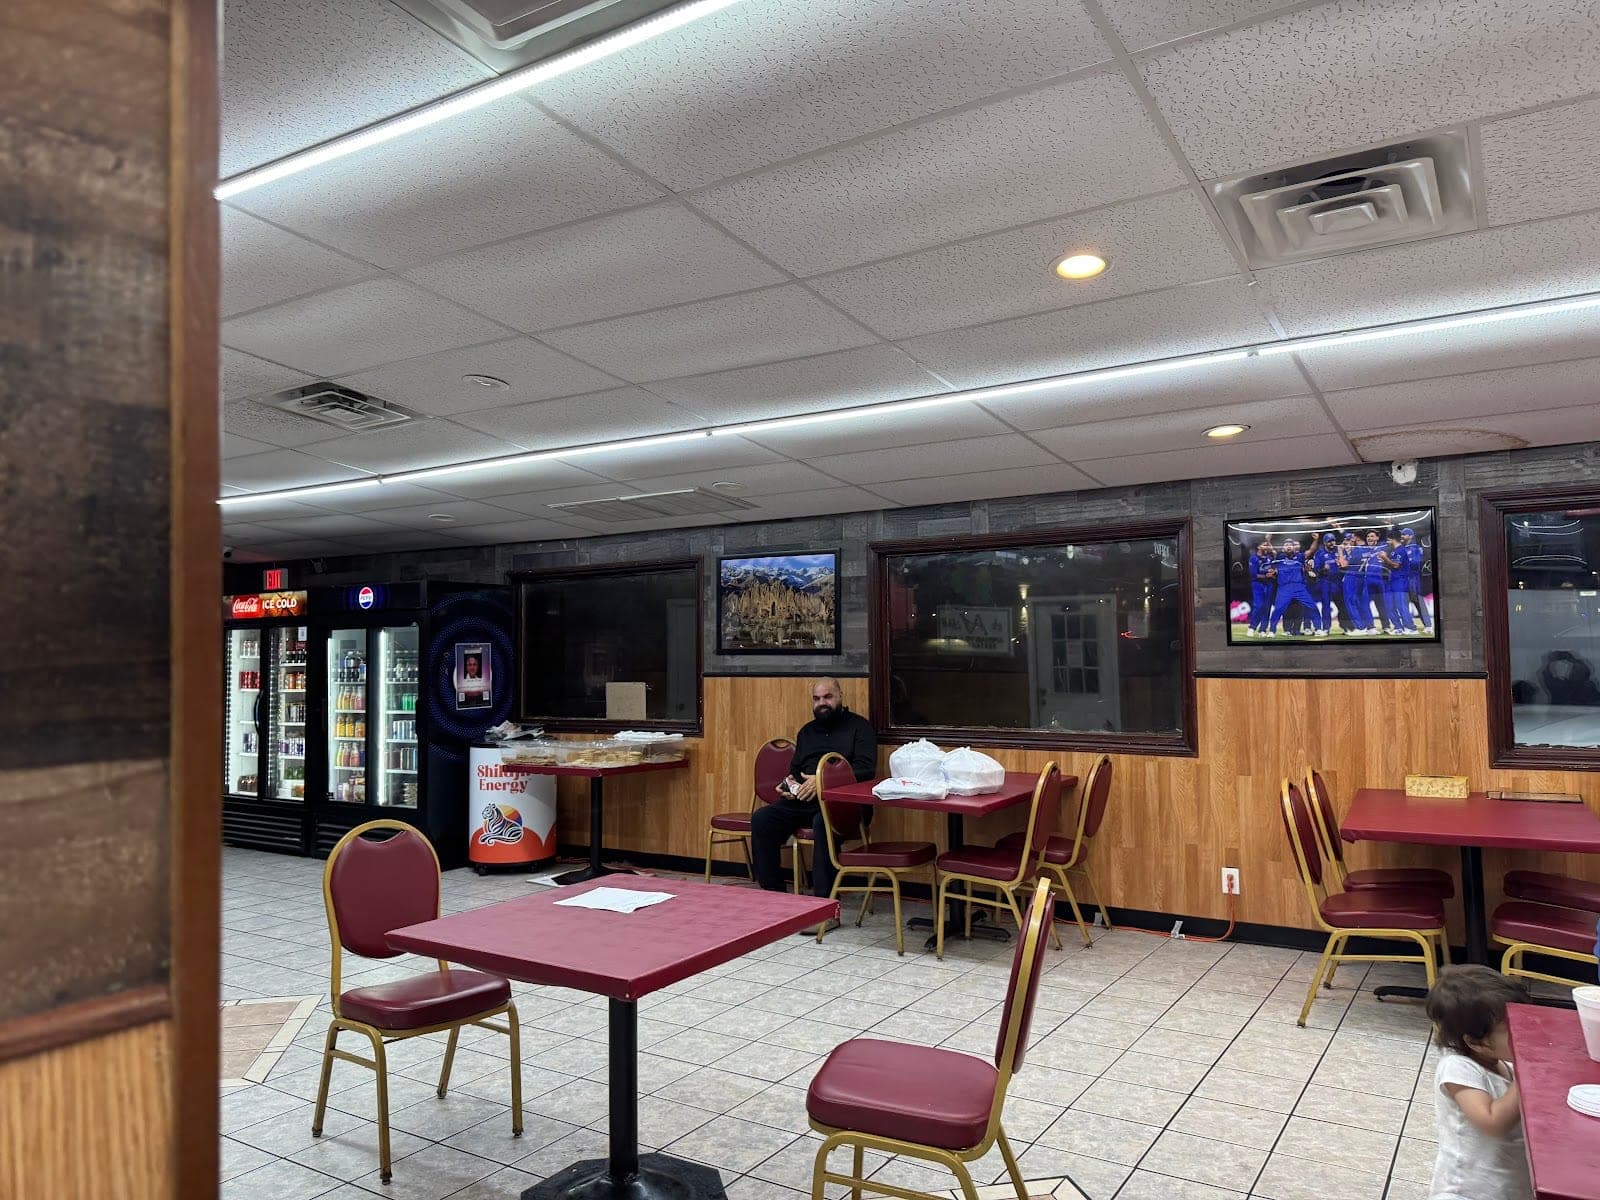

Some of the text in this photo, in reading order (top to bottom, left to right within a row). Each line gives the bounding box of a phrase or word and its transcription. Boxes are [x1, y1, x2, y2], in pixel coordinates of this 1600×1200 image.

[267, 570, 281, 590] EXIT
[262, 600, 274, 609] ICE
[276, 598, 297, 608] COLD
[479, 779, 528, 793] Energy
